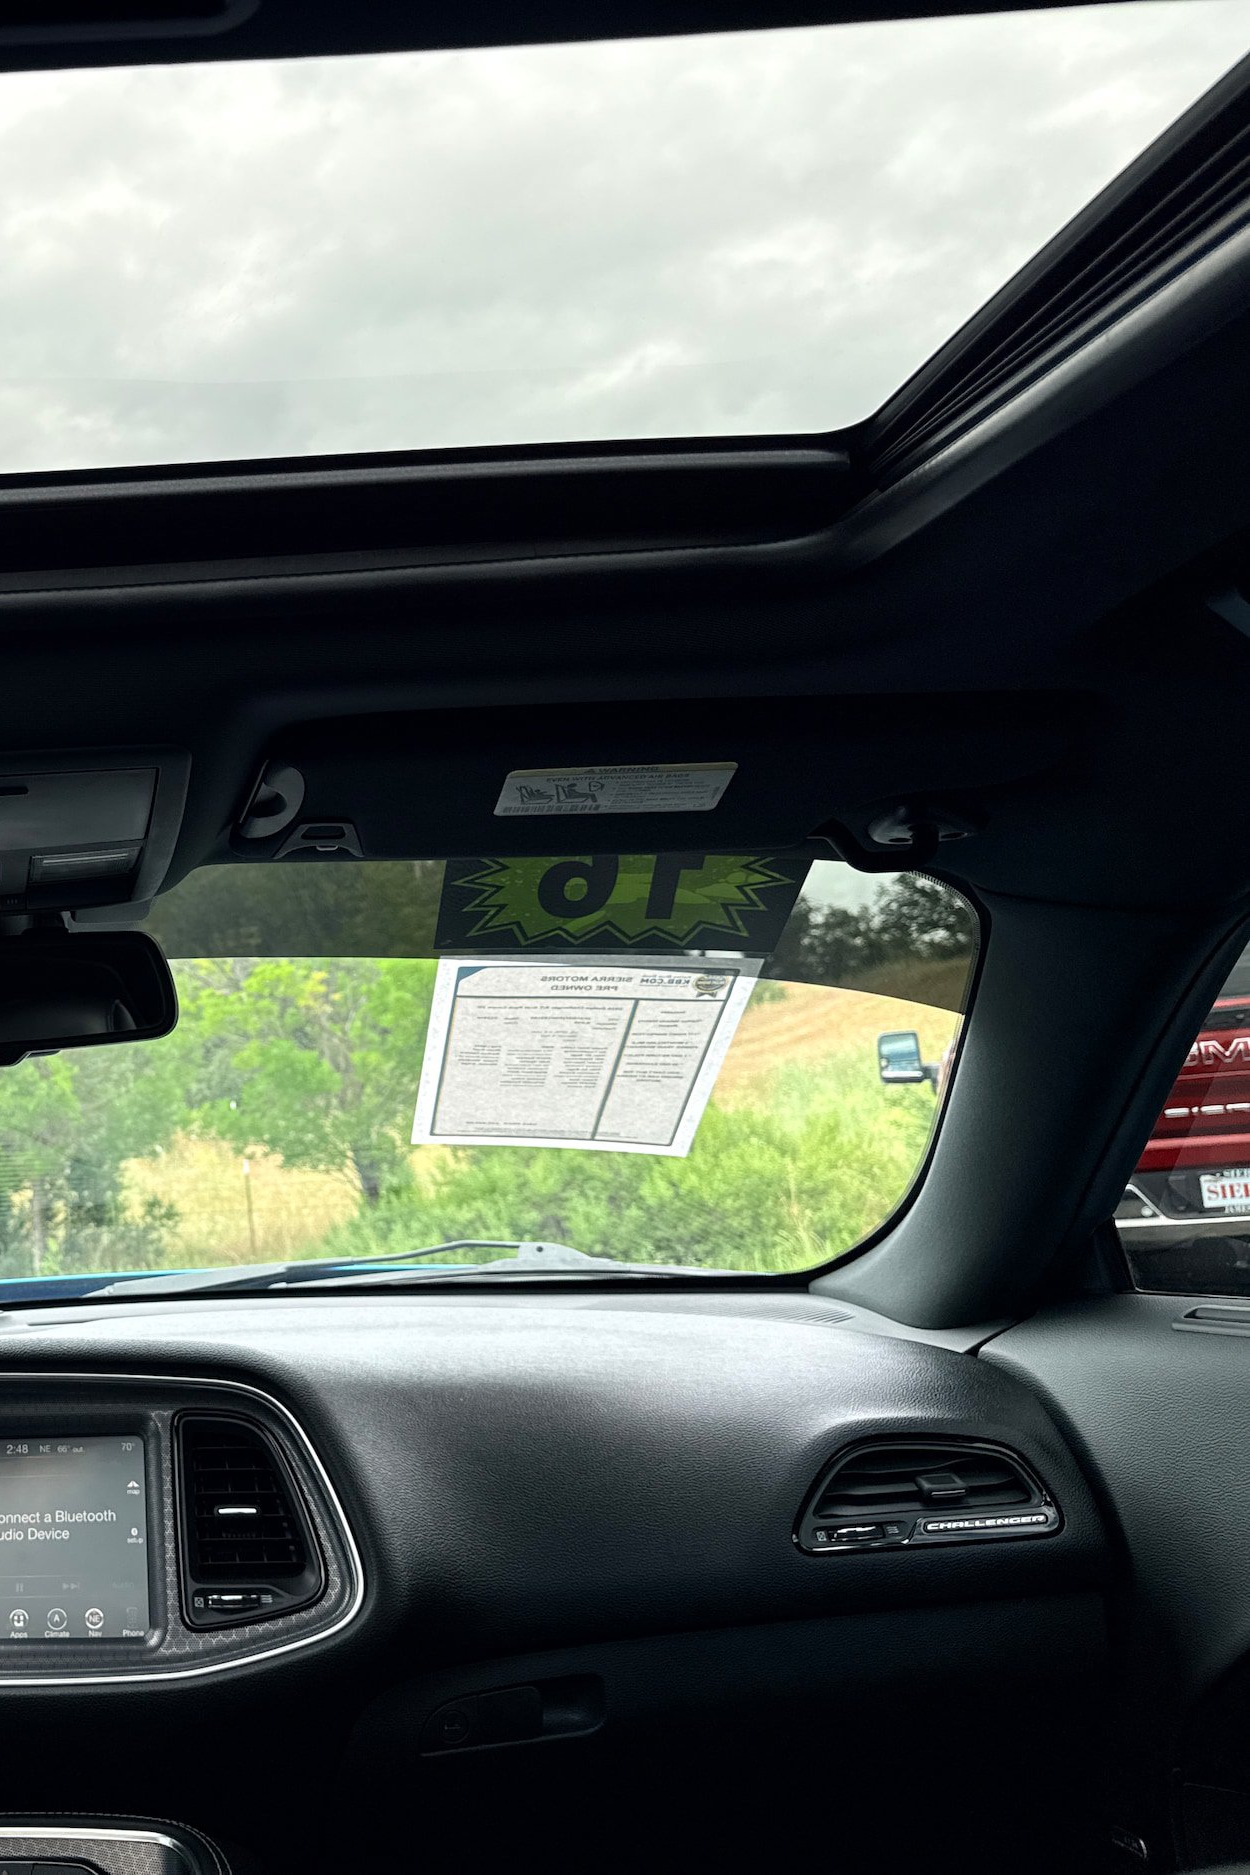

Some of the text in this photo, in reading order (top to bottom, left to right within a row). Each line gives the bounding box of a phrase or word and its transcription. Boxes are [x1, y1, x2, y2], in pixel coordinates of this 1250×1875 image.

[598, 766, 659, 774] WARNING
[598, 774, 646, 782] ADVANCED
[6, 1444, 29, 1455] 2:48
[39, 1445, 52, 1454] NE
[44, 1514, 52, 1523] a
[55, 1510, 116, 1523] Bluetooth
[927, 1515, 1046, 1531] CHALLENGER
[28, 1528, 70, 1540] Device
[10, 1631, 28, 1639] Apps
[44, 1630, 70, 1638] Climate
[122, 1629, 145, 1637] Phone
